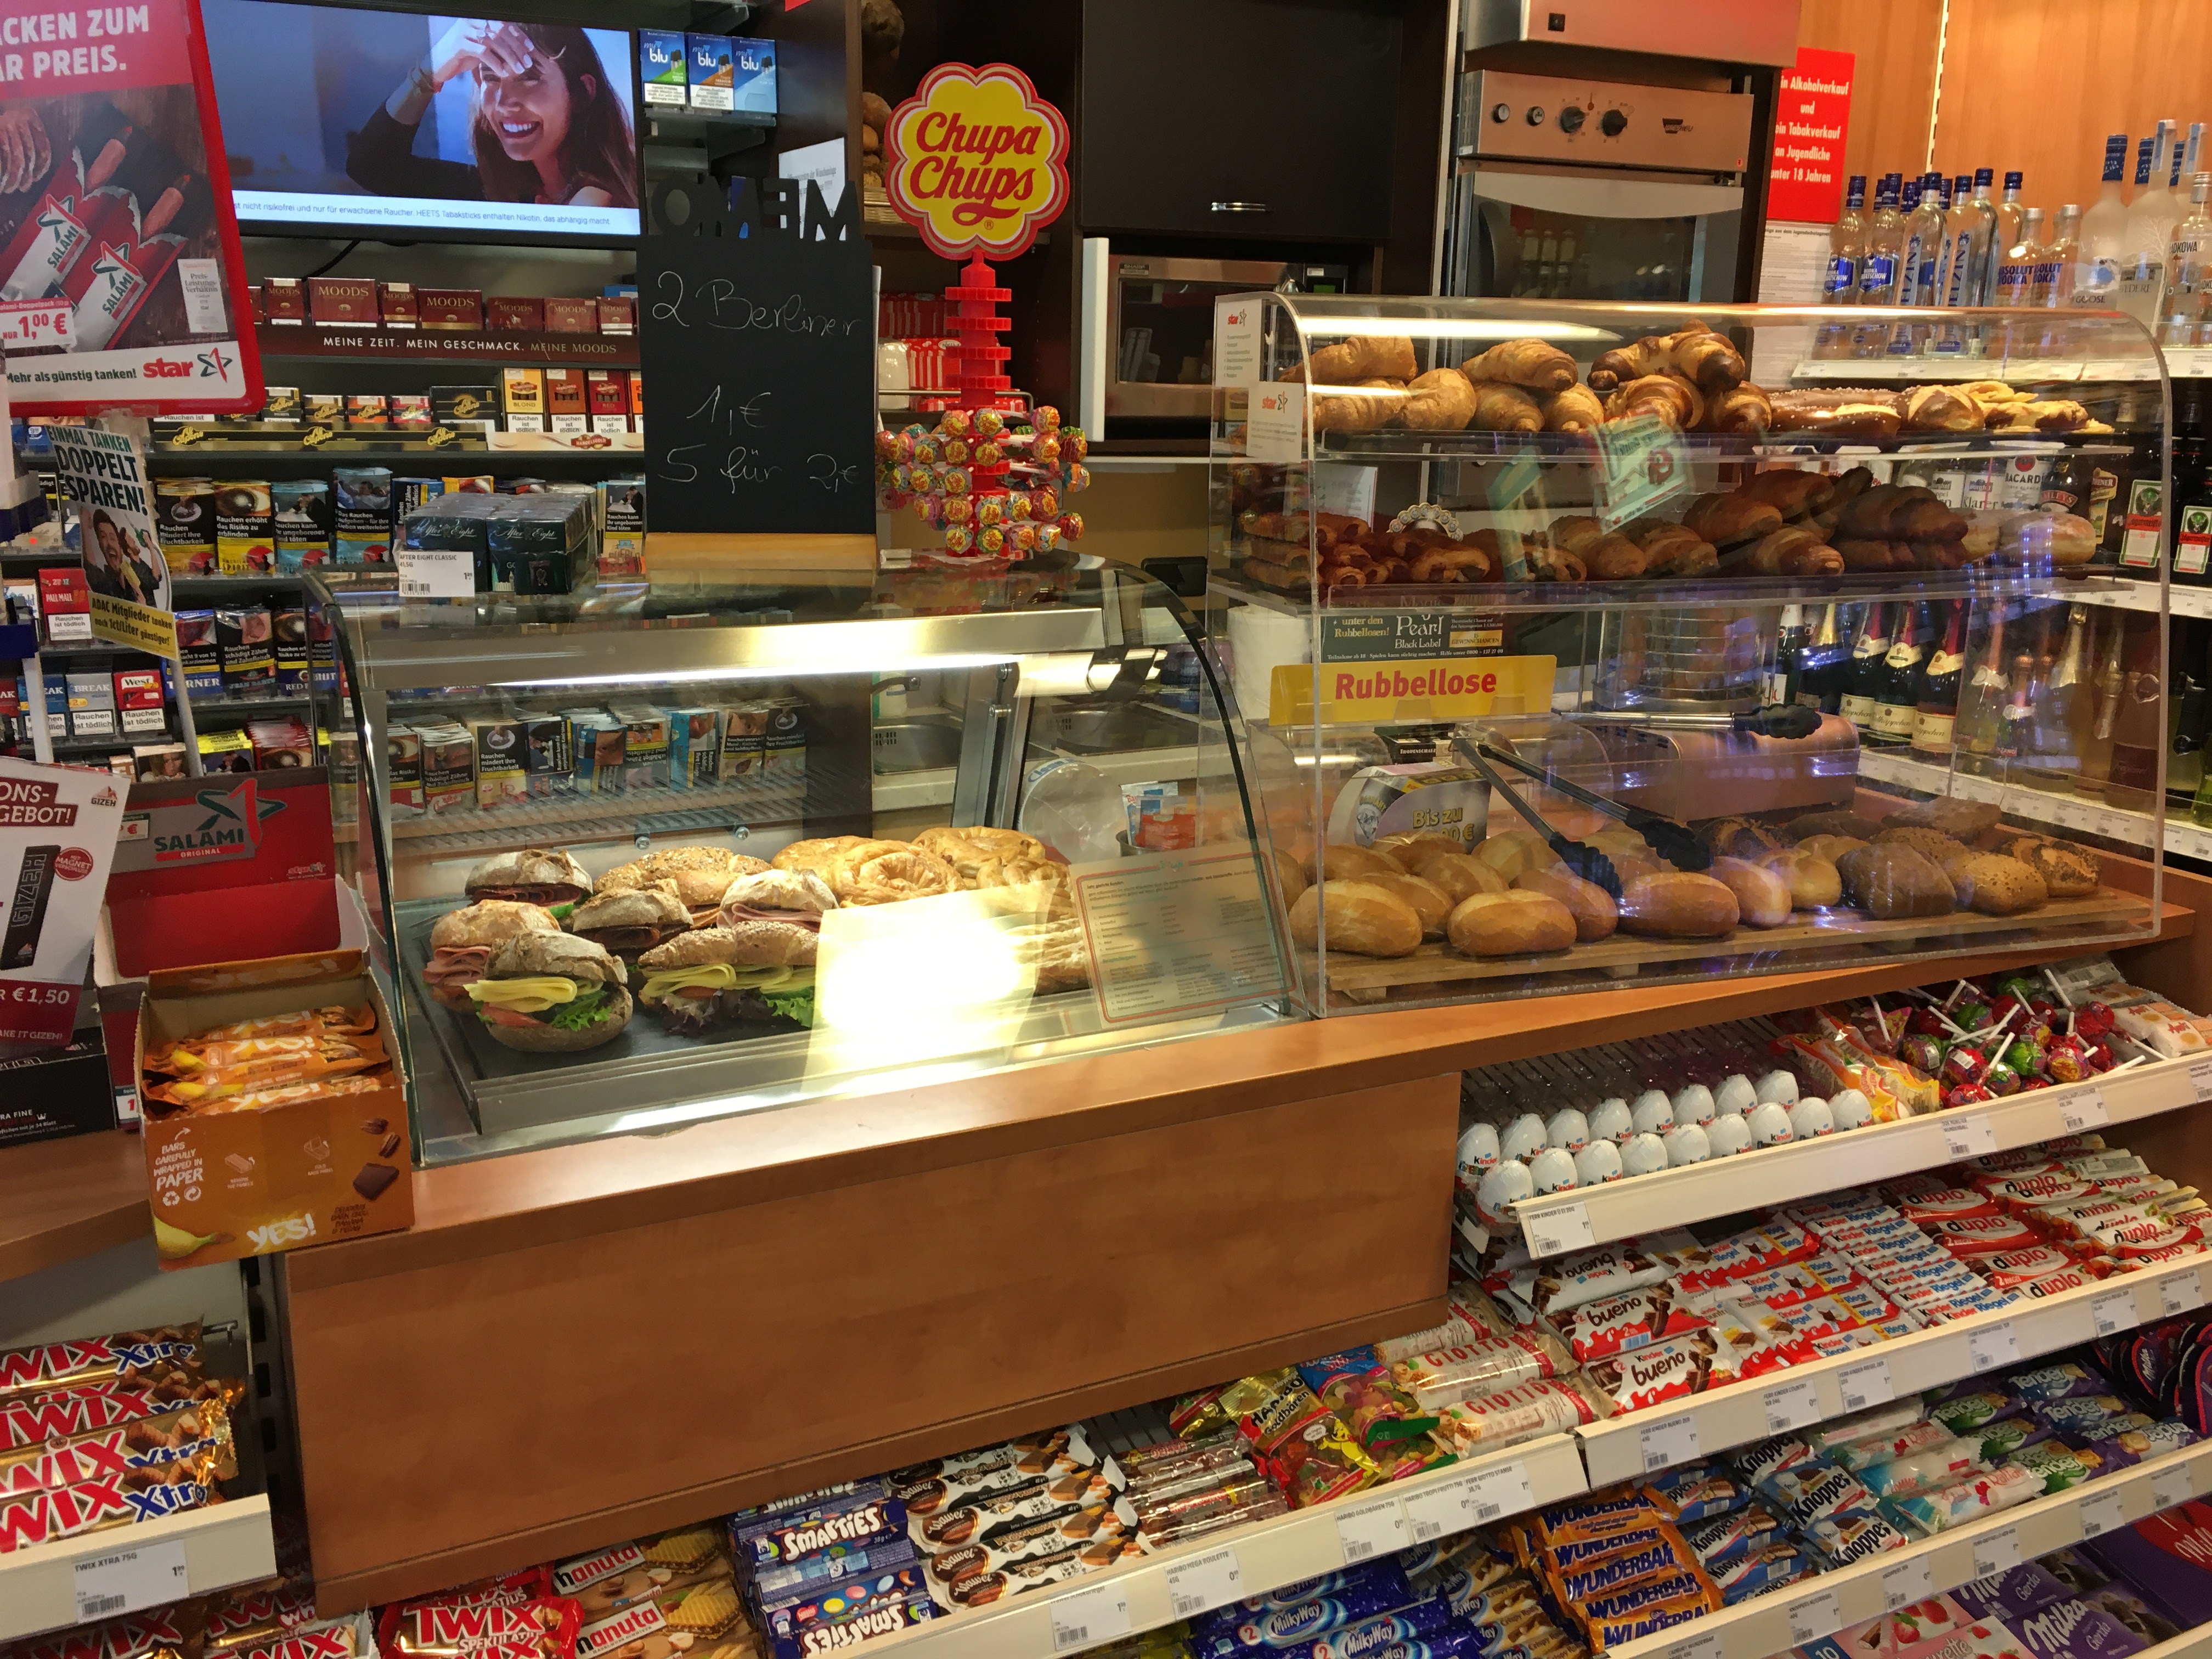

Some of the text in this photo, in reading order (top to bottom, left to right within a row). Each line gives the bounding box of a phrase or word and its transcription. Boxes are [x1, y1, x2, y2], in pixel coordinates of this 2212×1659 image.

[87, 5, 149, 37] ZUM
[33, 44, 127, 78] PREIS.
[649, 48, 668, 63] blu
[697, 52, 716, 67] blu
[741, 56, 759, 71] blu
[1791, 76, 1849, 95] Alkoholverkauf
[1801, 100, 1815, 114] und
[916, 111, 1042, 166] Chupa
[1789, 121, 1841, 139] Tabakverkauf
[1775, 144, 1830, 162] an Jugendliche
[1771, 168, 1831, 183] unter 18 Jahren
[910, 155, 1036, 225] Chups
[242, 202, 261, 211] nicht
[263, 202, 295, 212] risikofrei
[297, 205, 311, 213] und
[327, 205, 337, 214] für
[338, 206, 382, 216] erwachsene
[384, 207, 414, 217] Raucher.
[416, 209, 440, 218] HEETS
[442, 210, 481, 221] Tabaksticks
[483, 212, 515, 221] enthalten
[516, 213, 541, 224] Nikotin,
[543, 215, 556, 223] das
[557, 215, 588, 226] abhängig
[47, 225, 79, 268] SALAMI
[102, 272, 135, 315] SALAMI
[268, 287, 300, 296] MOODS
[318, 285, 369, 297] MOODS
[426, 297, 475, 308] MOODS
[499, 303, 533, 313] MOODS
[653, 271, 862, 336] 2 Berliner
[323, 336, 617, 355] MEINE ZEIT. MEIN GESCHMACK. MEINE MOODS
[7, 371, 32, 382] Mehr
[34, 371, 49, 382] als
[52, 370, 92, 383] günstig
[94, 368, 137, 380] tanken!
[143, 358, 194, 378] star
[46, 425, 132, 453] EINMAL TANKEN
[54, 445, 138, 482] DOPPELT
[658, 443, 707, 482] 5
[720, 446, 782, 494] für
[65, 475, 148, 516] SPAREN!
[92, 598, 172, 629] ADAC Mitglieder tanken
[1342, 616, 1383, 625] unter den
[1334, 627, 1390, 637] Rubbellosen!
[1396, 615, 1444, 636] Pearl
[1395, 638, 1441, 648] Black Label
[1335, 668, 1497, 700] Rubbellose
[125, 710, 160, 718] Rauchen
[136, 717, 163, 726] tödlich
[86, 720, 112, 729] tödlich
[91, 797, 116, 806] GIZEH
[1413, 807, 1463, 829] Bis zu
[154, 828, 245, 852] SALAMI
[56, 856, 92, 868] MAGNET
[180, 848, 221, 858] ORIGINAL
[14, 1109, 33, 1118] FINE
[155, 1148, 196, 1166] CAREFULLY
[161, 1142, 185, 1154] BARS
[154, 1157, 202, 1177] WRAPPED IN
[156, 1167, 204, 1192] PAPER
[1906, 1189, 1966, 1207] duplo
[1846, 1209, 1876, 1222] Riegel
[1946, 1215, 2007, 1233] duplo
[246, 1213, 317, 1252] YES!
[1864, 1222, 1895, 1235] Riegel
[1878, 1237, 1911, 1250] Riegel
[1896, 1250, 1929, 1263] Riegel
[1991, 1246, 2050, 1269] duplo
[1914, 1265, 1945, 1278] Riegel
[1931, 1279, 1962, 1293] Riegel
[2029, 1272, 2083, 1299] duplo
[1589, 1297, 1642, 1327] bueno
[1974, 1299, 2006, 1312] Riegel
[1424, 1335, 1511, 1368] GIOTTO
[1630, 1350, 1686, 1386] bueno
[2009, 1365, 2066, 1389] Tender
[1465, 1378, 1552, 1414] GIOTTO
[1265, 1389, 1311, 1437] Goldbären
[1466, 1476, 1477, 1486] FERR
[123, 1480, 207, 1523] Xtra
[1404, 1483, 1454, 1504] HARIBO TROPI FRUTTI
[1793, 1474, 1853, 1525] Knoppers
[1337, 1510, 1356, 1521] HARIBO
[783, 1504, 881, 1562] SMARTIES
[75, 1552, 137, 1572] TWIX XTRA 75G
[554, 1543, 640, 1590] hanuta
[1167, 1550, 1229, 1576] HARIBO MEGA ROULETTE
[1586, 1575, 1703, 1619] WUNDERBAR
[413, 1604, 548, 1645] TWIX
[577, 1606, 660, 1656] hanuta
[2023, 1599, 2089, 1653] Milka
